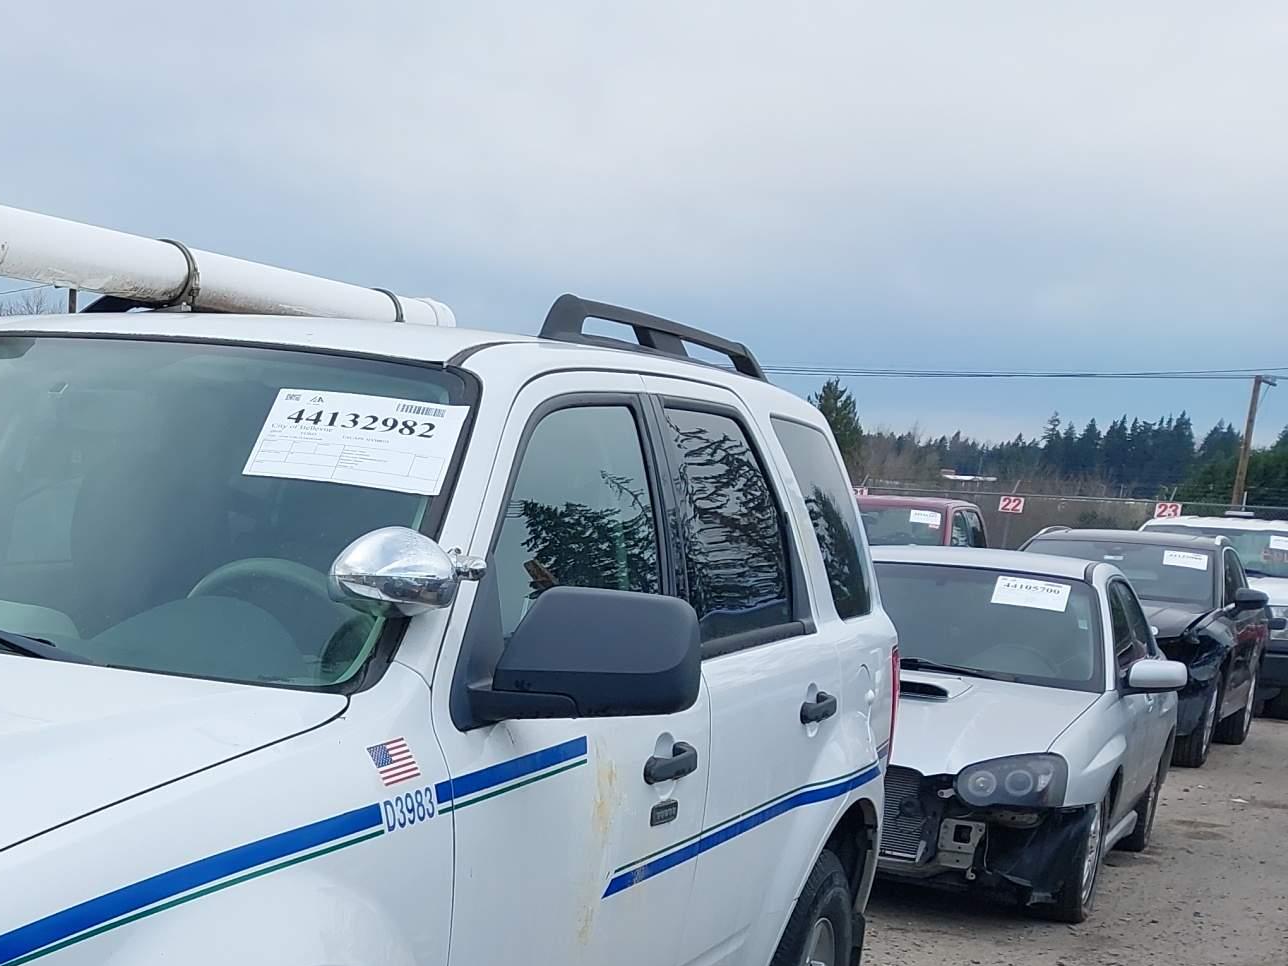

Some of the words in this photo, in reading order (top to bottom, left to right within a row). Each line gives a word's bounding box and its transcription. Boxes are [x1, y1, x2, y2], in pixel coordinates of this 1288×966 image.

[287, 408, 436, 439] 44132982
[1001, 497, 1022, 512] 22
[1156, 503, 1180, 517] 23
[383, 787, 435, 832] D3983
